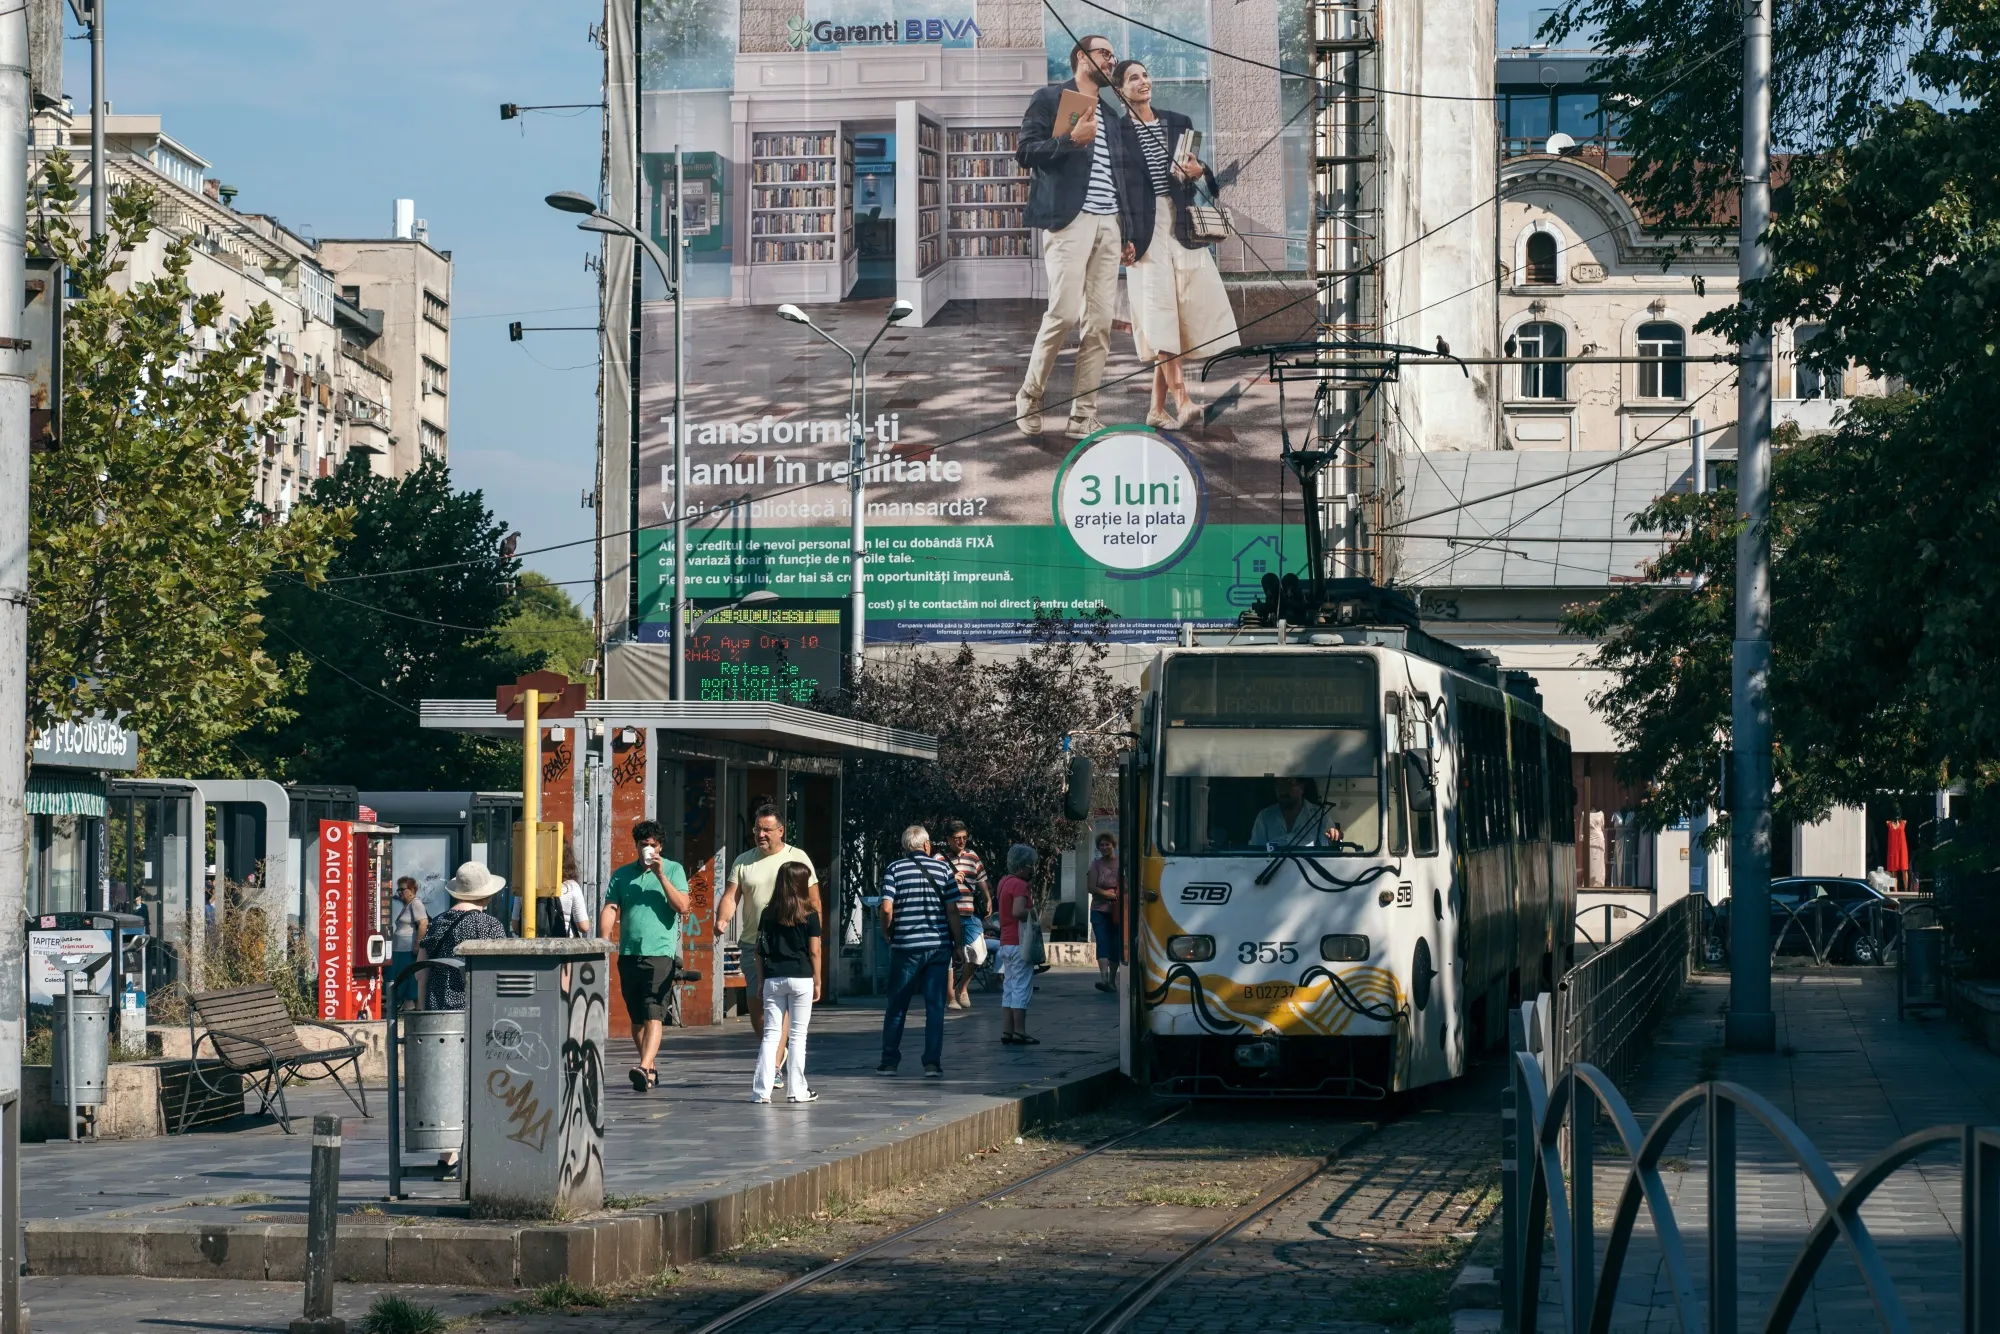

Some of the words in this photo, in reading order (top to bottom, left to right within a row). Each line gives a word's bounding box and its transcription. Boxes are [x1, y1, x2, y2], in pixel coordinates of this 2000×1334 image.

[814, 20, 899, 43] Garanti
[905, 17, 982, 40] BBVA
[661, 455, 765, 493] planul
[776, 456, 806, 485] în
[1079, 475, 1101, 506] 3
[1115, 474, 1180, 506] luni
[661, 500, 704, 520] Vei
[711, 505, 724, 519] o
[730, 497, 834, 519] bibliotecă
[841, 498, 852, 517] î
[868, 497, 988, 518] mansardă?
[1074, 512, 1122, 529] grație
[1127, 512, 1140, 525] la
[1145, 512, 1186, 528] plata
[696, 540, 742, 550] creditul
[745, 540, 760, 550] de
[763, 539, 795, 550] nevoi
[875, 538, 889, 549] lei
[892, 540, 907, 549] cu
[910, 537, 963, 549] dobândă
[966, 535, 995, 548] FIXĂ
[1103, 531, 1158, 545] ratelor
[688, 554, 731, 566] variază
[734, 555, 761, 565] doar
[764, 555, 776, 565] în
[778, 554, 821, 567] funcție
[824, 554, 839, 564] de
[888, 552, 915, 563] tale.
[659, 574, 702, 585] Fieare
[705, 575, 720, 584] cu
[723, 573, 750, 584] visul
[754, 573, 772, 585] lui,
[775, 573, 796, 583] dar
[798, 572, 817, 583] hai
[820, 572, 834, 582] să
[877, 571, 950, 585] oportunități
[953, 570, 1014, 584] împreună.
[868, 600, 895, 611] cost)
[897, 600, 906, 611] și
[909, 600, 919, 608] te
[922, 599, 978, 608] contactăm
[981, 600, 997, 608] noi
[1000, 599, 1031, 608] direct
[732, 609, 817, 622] BUCURESTI
[693, 636, 711, 648] 17
[720, 636, 751, 649] Aug
[800, 636, 819, 648] 10
[720, 662, 770, 675] Retea
[701, 688, 779, 700] CALITATE
[55, 720, 128, 755] FLOWERS
[325, 848, 341, 884] AICI
[1180, 886, 1228, 901] STB
[1397, 886, 1412, 903] STB
[325, 889, 340, 951] Cartela
[1237, 941, 1300, 964] 355
[1244, 986, 1254, 999] B
[1256, 985, 1295, 999] 02737
